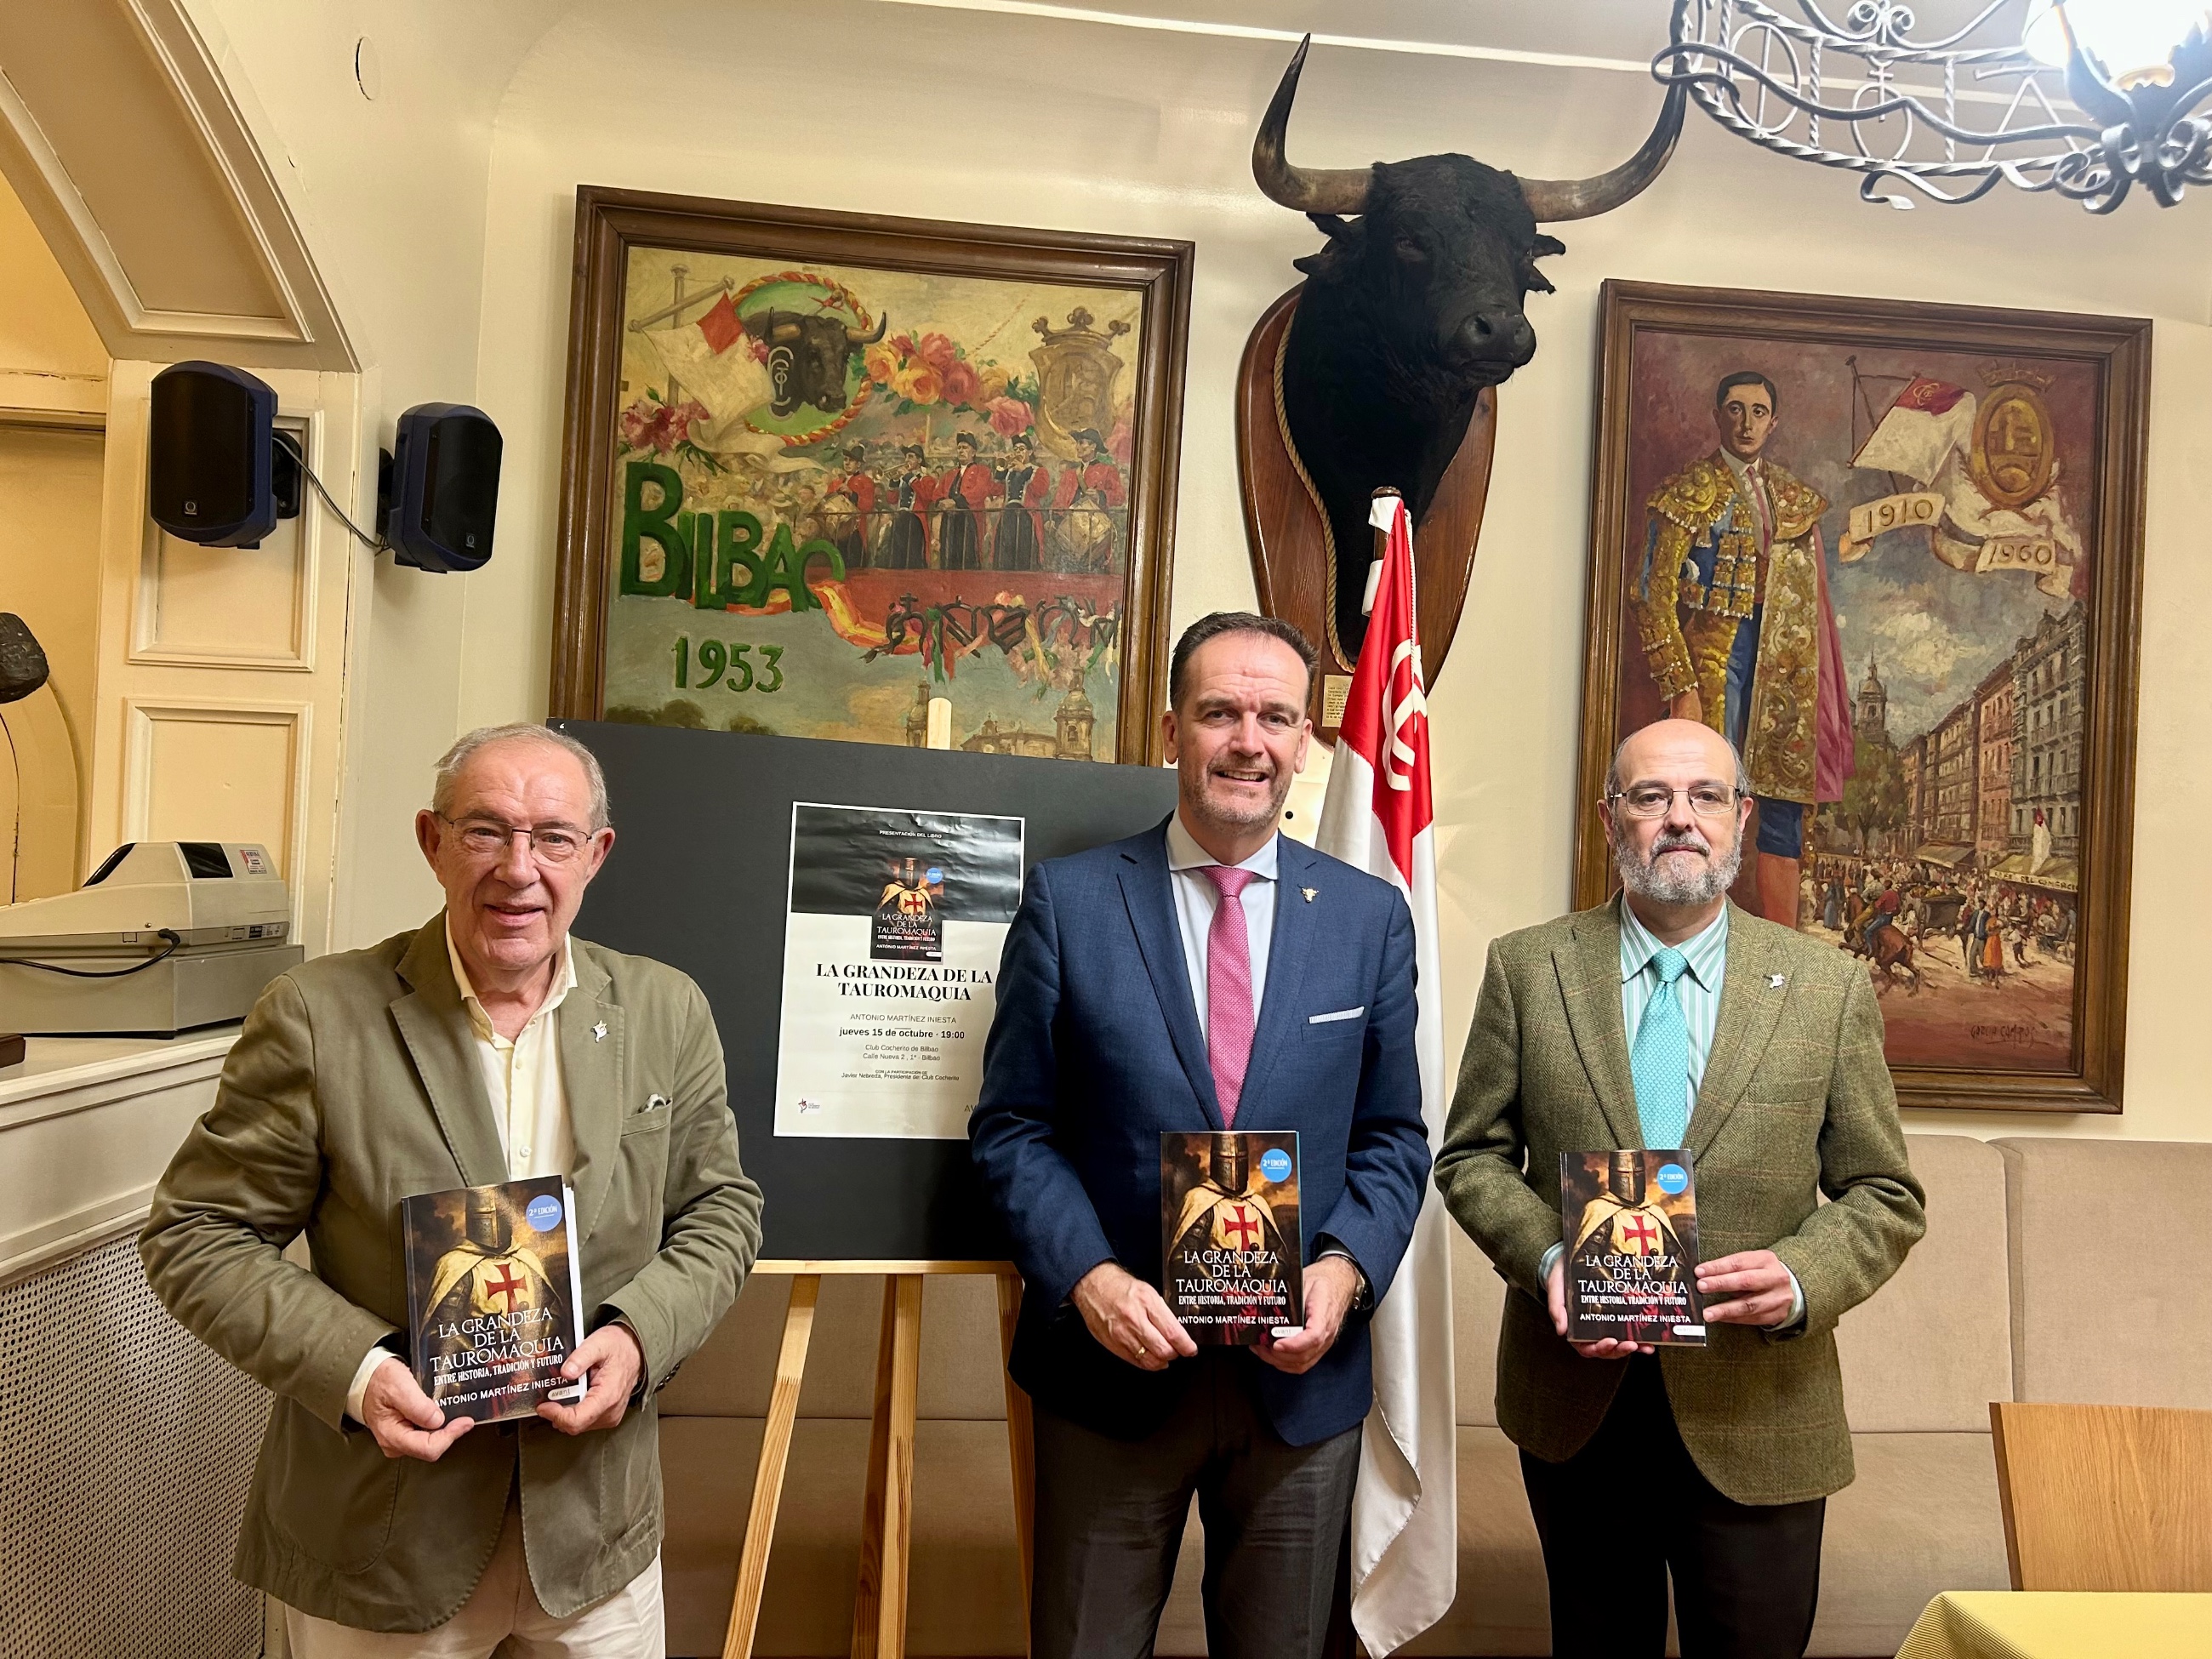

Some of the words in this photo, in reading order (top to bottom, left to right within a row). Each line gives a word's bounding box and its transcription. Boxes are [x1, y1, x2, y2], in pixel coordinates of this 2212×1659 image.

[1867, 499, 1934, 533] 1910
[620, 462, 846, 613] BILBAO
[1988, 544, 2052, 566] 1960
[670, 636, 785, 693] 1953
[892, 914, 933, 922] GRANDEZA
[876, 926, 937, 937] TAUROMAQUIA
[816, 963, 839, 978] LA
[843, 963, 938, 982] GRANDEZA
[943, 968, 966, 983] DE
[972, 970, 993, 983] LA
[838, 983, 972, 1002] TAUROMAQUIA
[850, 1013, 886, 1022] ANTONIO
[887, 1013, 926, 1023] MARTÍNEZ
[839, 1027, 869, 1037] jueves
[885, 1028, 897, 1037] de
[898, 1029, 933, 1038] octubre
[940, 1030, 965, 1040] 19:00
[537, 1204, 558, 1215] EDICIÓN
[1183, 1251, 1200, 1264] LA
[1202, 1251, 1279, 1264] GRANDEZA
[1585, 1255, 1602, 1267] LA
[1604, 1255, 1679, 1268] GRANDEZA
[1212, 1264, 1231, 1278] DE
[1234, 1264, 1251, 1278] LA
[1613, 1268, 1632, 1280] DE
[1634, 1268, 1652, 1280] LA
[1176, 1279, 1288, 1295] TAUROMAQUIA
[1577, 1280, 1689, 1296] TAUROMAQUIA
[1178, 1295, 1197, 1305] ENTRE
[1197, 1295, 1226, 1306] HISTORIA,
[1227, 1294, 1257, 1306] TRADICIÓN
[1258, 1296, 1263, 1306] Y
[1263, 1296, 1286, 1306] FUTURO
[1581, 1295, 1599, 1304] ENTRE
[1599, 1295, 1628, 1306] HISTORIA,
[1628, 1294, 1659, 1305] TRADICIÓN
[1659, 1296, 1664, 1305] Y
[1664, 1296, 1687, 1306] FUTURO
[437, 1323, 460, 1339] LA
[461, 1307, 553, 1334] GRANDEZA
[1177, 1315, 1214, 1325] ANTONIO
[1215, 1314, 1257, 1325] MARTÍNEZ
[1257, 1316, 1291, 1325] INIESTA
[1579, 1313, 1616, 1322] ANTONIO
[1617, 1313, 1658, 1323] MARTÍNEZ
[1659, 1314, 1691, 1323] INIESTA
[474, 1332, 497, 1348] DE
[499, 1328, 522, 1343] LA
[429, 1336, 565, 1372] TAUROMAQUIA
[434, 1373, 457, 1387] ENTRE
[458, 1368, 492, 1382] HISTORIA,
[493, 1359, 530, 1376] TRADICIÓN
[530, 1360, 536, 1369] Y
[536, 1354, 563, 1368] FUTURO
[480, 1382, 530, 1400] MARTÍNEZ
[531, 1377, 568, 1390] INIESTA
